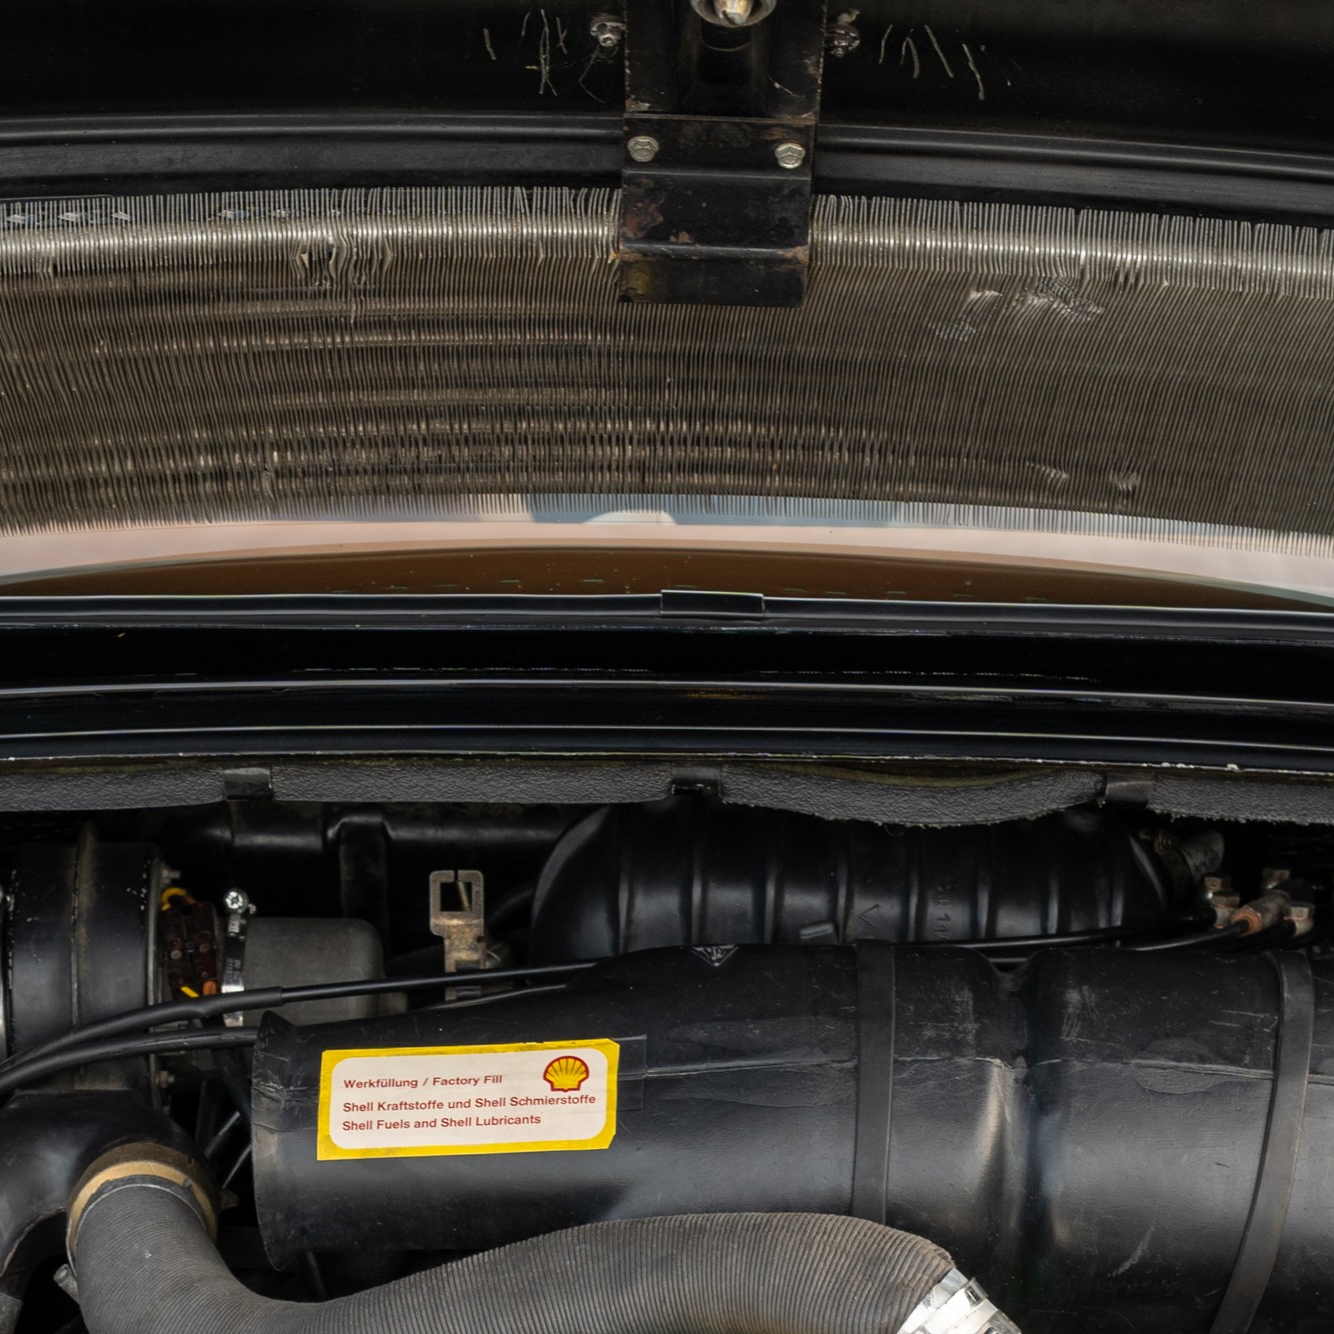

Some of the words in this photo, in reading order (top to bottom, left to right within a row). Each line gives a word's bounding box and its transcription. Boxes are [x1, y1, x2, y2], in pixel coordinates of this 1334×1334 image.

[343, 1077, 418, 1089] Werkfüllung
[432, 1076, 480, 1088] Factory
[484, 1075, 503, 1085] Fill
[343, 1101, 374, 1112] Shell
[377, 1099, 444, 1111] Kraftstoffe
[448, 1098, 471, 1110] und
[475, 1096, 506, 1108] Shell
[510, 1094, 596, 1107] Schmierstoffe
[342, 1120, 373, 1131] Shell
[376, 1119, 410, 1130] Fuels
[413, 1118, 437, 1129] and
[441, 1116, 472, 1127] Shell
[475, 1114, 541, 1126] Lubricants
